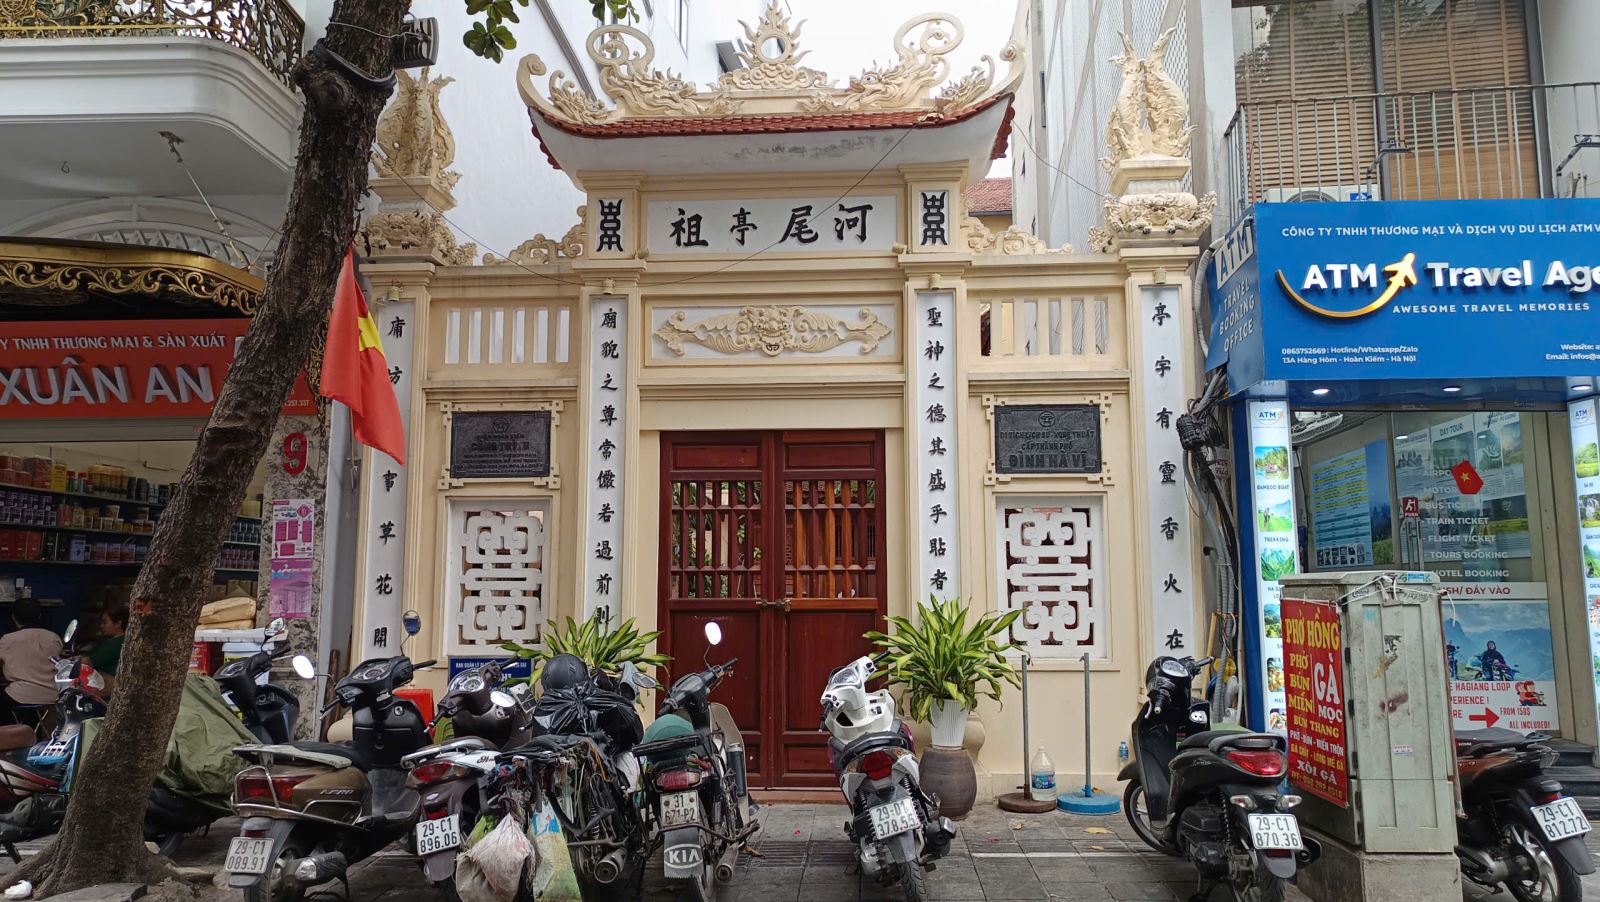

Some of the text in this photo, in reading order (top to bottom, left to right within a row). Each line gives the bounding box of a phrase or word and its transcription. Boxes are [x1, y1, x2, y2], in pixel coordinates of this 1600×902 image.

[1282, 226, 1315, 237] CÔNG
[1318, 227, 1333, 236] TY
[1335, 227, 1367, 236] TNHH
[1367, 225, 1418, 235] THƯƠNG
[1422, 226, 1444, 237] MẠI
[1448, 223, 1463, 234] VÀ
[1466, 225, 1496, 236] DỊCH
[1499, 225, 1514, 236] VỤ
[1519, 224, 1536, 233] DU
[1539, 224, 1566, 235] LỊCH
[1570, 224, 1593, 233] ATM
[1303, 263, 1378, 290] ATM
[1426, 259, 1533, 288] Travel
[1223, 277, 1250, 312] TRAVEL
[1219, 294, 1255, 336] BOOKING
[1393, 302, 1590, 313] AWESOME TRAVEL MEMORIES
[1223, 318, 1255, 353] OFFICE
[13, 338, 49, 349] TNHH
[52, 336, 107, 349] THƯƠNG
[111, 337, 139, 351] MẠI
[143, 336, 153, 348] &
[0, 356, 214, 405] XUÂN AN
[1575, 409, 1588, 417] ATM
[283, 432, 309, 475] 9
[1422, 469, 1452, 477] AIRPO
[1427, 517, 1489, 525] TRAIN TICKET
[1462, 534, 1496, 542] TICKET
[1430, 551, 1463, 559] TOURS
[1490, 584, 1511, 595] VÀO
[1285, 608, 1340, 650] PHỞ HỒNG
[1289, 650, 1309, 669] PHỞ
[1289, 671, 1310, 691] BÚN
[1314, 652, 1340, 705] GÀ
[1455, 682, 1490, 691] HAGIANG
[1491, 682, 1511, 690] LOOP
[1287, 691, 1313, 713] MIẾN
[1318, 704, 1343, 724] MỌC
[1293, 714, 1340, 738] BÚN THANG
[1509, 720, 1520, 729] ALL
[1320, 770, 1337, 785] GÀ
[673, 794, 684, 808] 31
[1539, 802, 1574, 822] 29-C1
[422, 817, 452, 837] 29-C1
[1256, 816, 1290, 831] 29-C1
[1545, 816, 1588, 838] 812.72
[420, 831, 457, 853] 896.06
[1255, 832, 1299, 847] 870.36
[235, 840, 266, 855] 29-C1
[227, 856, 265, 871] 089.91
[669, 849, 700, 863] KIA
